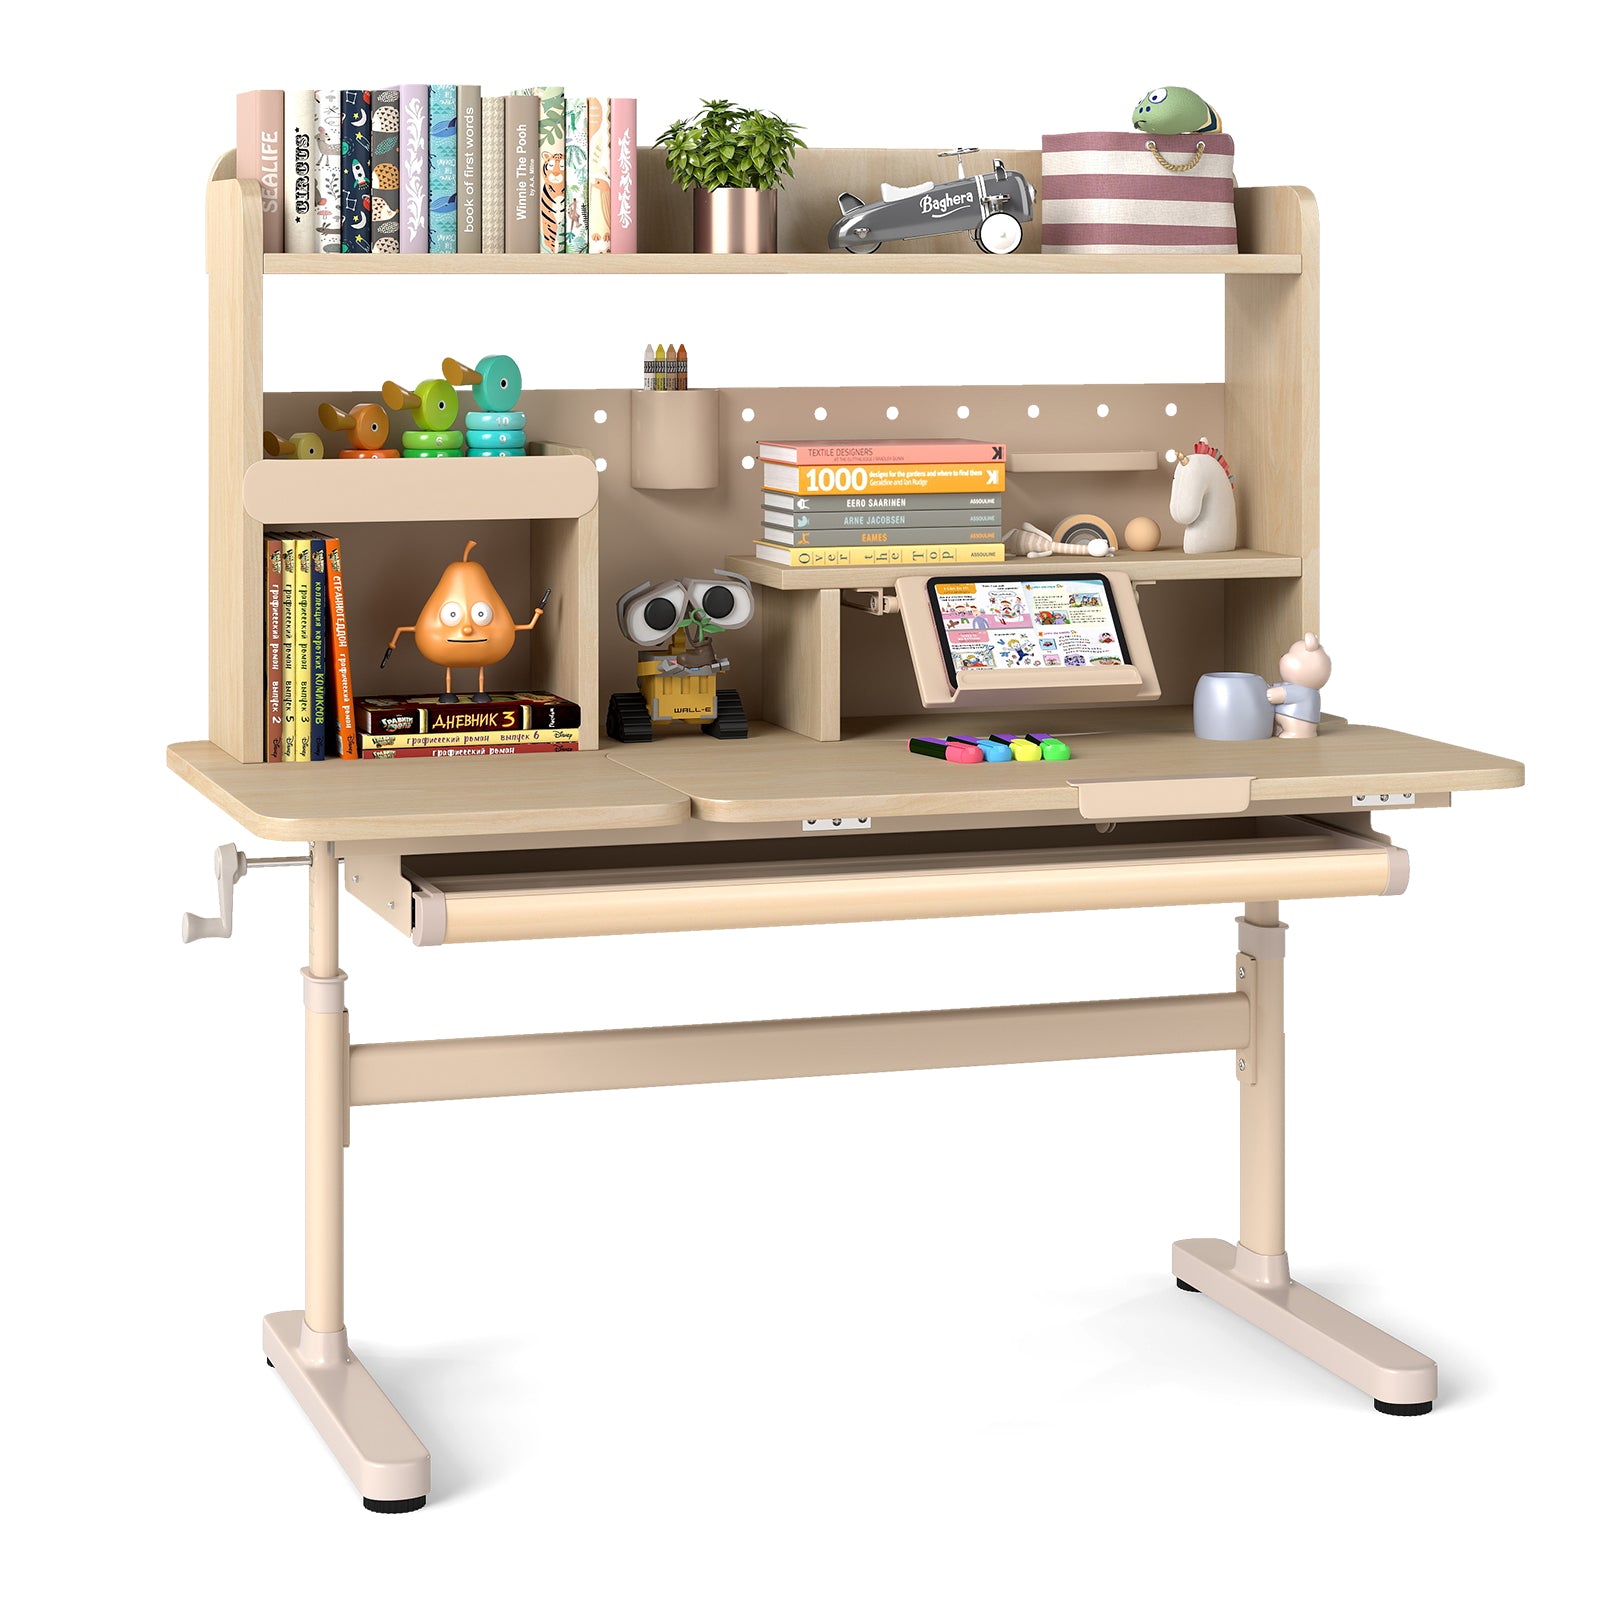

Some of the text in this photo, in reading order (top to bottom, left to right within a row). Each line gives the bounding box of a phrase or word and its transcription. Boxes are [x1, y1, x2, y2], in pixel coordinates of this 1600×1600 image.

[261, 131, 279, 213] SEALIFE
[295, 133, 310, 215] CIRCUS
[464, 107, 474, 233] book of first words
[516, 124, 527, 220] Winnie The Pooh
[529, 188, 536, 197] by
[920, 191, 974, 214] Baghera
[808, 447, 874, 457] TEXTILE DESIGNERS
[806, 467, 868, 492] 1000
[869, 471, 888, 479] designs
[889, 470, 897, 478] for
[897, 470, 905, 478] the
[906, 470, 927, 478] gardens
[959, 469, 969, 477] find
[970, 469, 983, 477] them
[870, 478, 894, 486] Geraldine
[894, 478, 903, 486] and
[847, 498, 906, 507] EERO SAARINEN
[844, 516, 905, 525] ARNE JACOBSEN
[862, 533, 888, 542] EAMES
[798, 550, 954, 564] Over the Top
[313, 581, 322, 627] коллекция
[332, 575, 347, 647] СТРАННОГЕДДОН
[269, 643, 279, 670] роман
[283, 643, 292, 670] роман
[298, 643, 308, 670] роман
[312, 630, 322, 670] коротких
[338, 653, 351, 702] графический
[270, 681, 280, 712] выпуск
[283, 681, 293, 711] выпуск
[298, 681, 308, 712] выпуск
[314, 673, 324, 725] КОМИКСОВ
[272, 716, 281, 724] 2
[285, 715, 294, 723] 5
[343, 705, 353, 729] роман
[432, 711, 516, 729] ДНЕВНИК 3
[271, 737, 281, 757] Disney
[284, 736, 294, 757] Disney
[300, 736, 310, 757] Disney
[346, 734, 355, 754] Disney
[464, 734, 490, 744] роман
[500, 733, 530, 742] выпуск
[533, 731, 540, 740] 6
[553, 731, 573, 740] Disney
